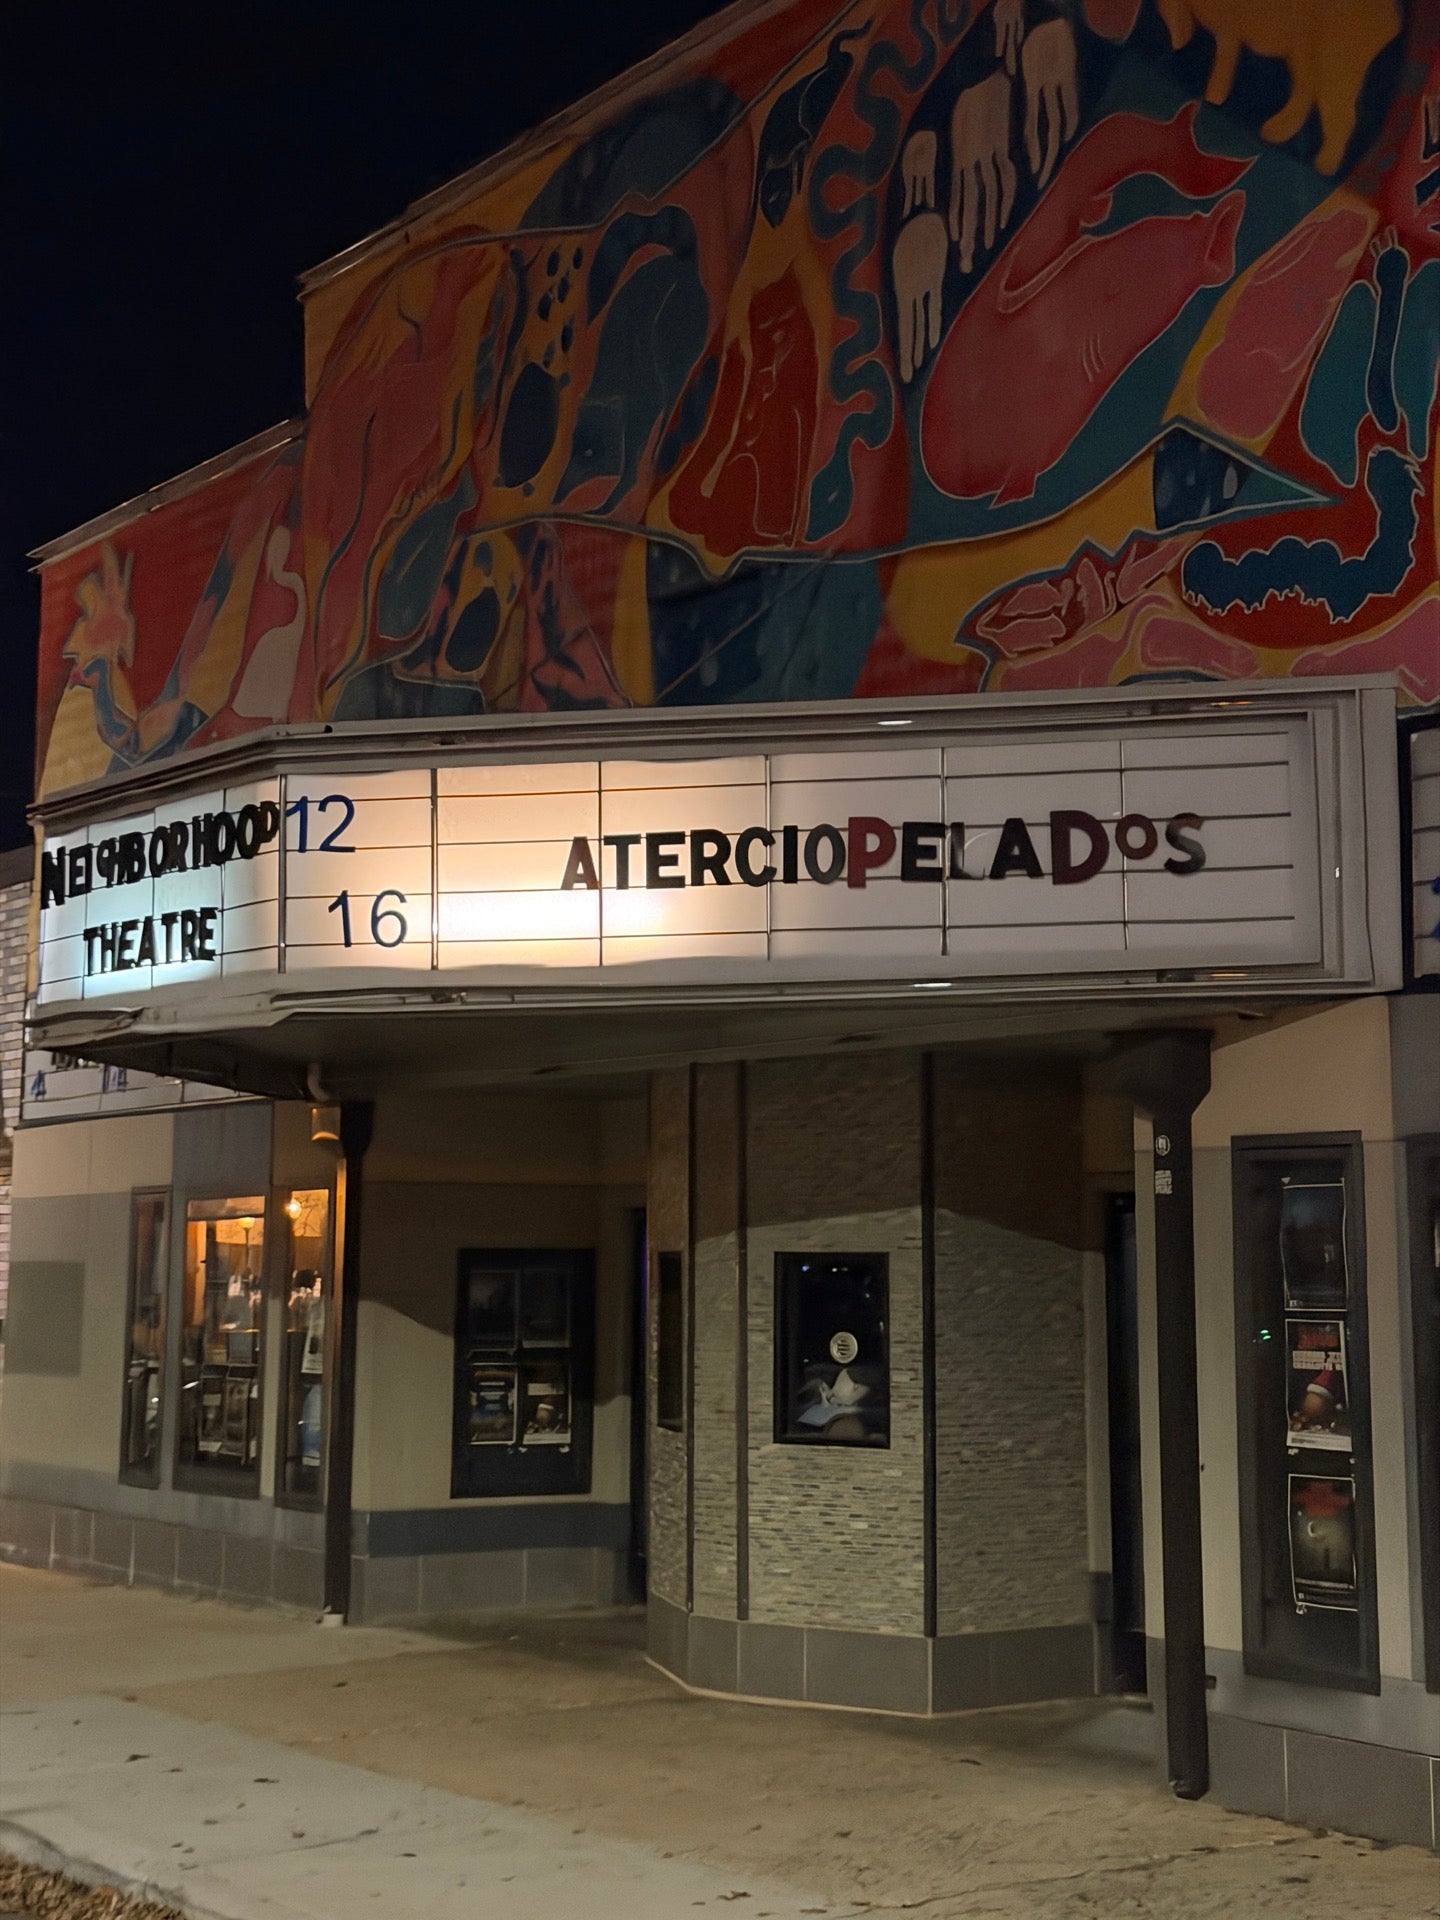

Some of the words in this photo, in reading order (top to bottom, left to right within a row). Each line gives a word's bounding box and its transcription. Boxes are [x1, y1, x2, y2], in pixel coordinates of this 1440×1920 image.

[41, 801, 280, 909] NEIGHBORHOOD
[286, 794, 356, 853] 12
[560, 810, 1206, 889] ATERCIOPELADOS
[84, 907, 218, 976] THEATRE
[328, 889, 408, 948] 16
